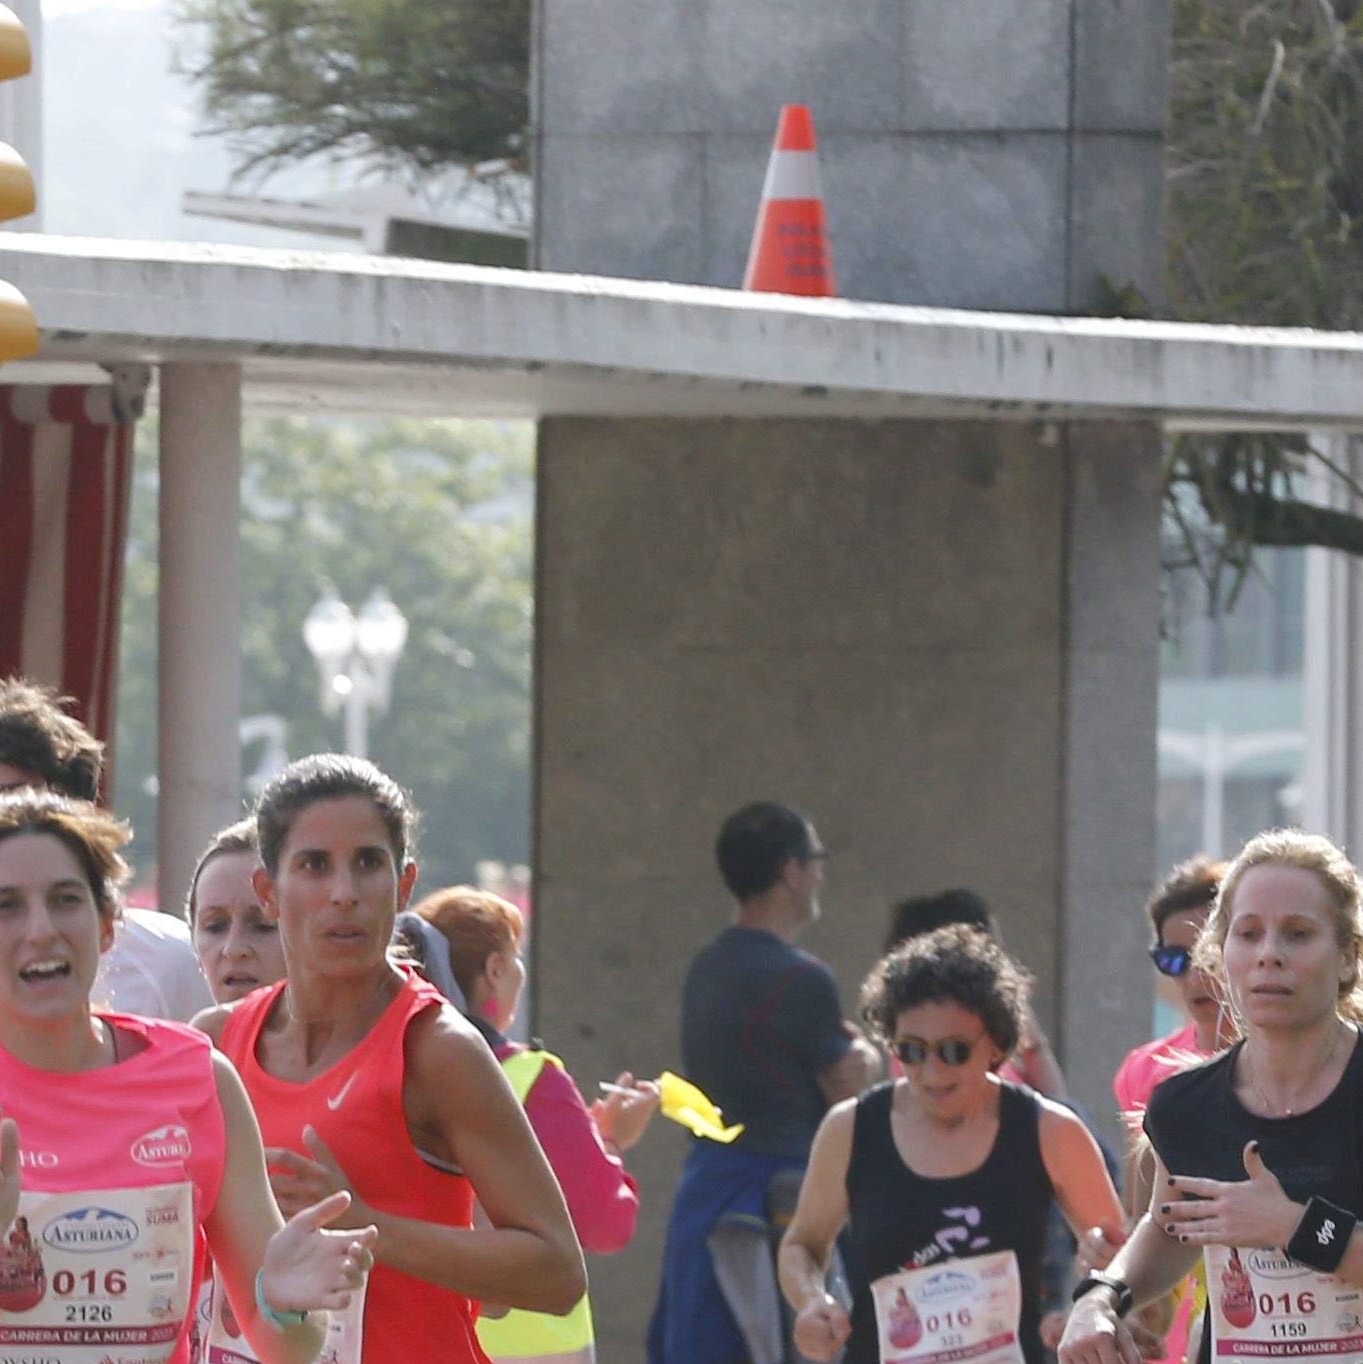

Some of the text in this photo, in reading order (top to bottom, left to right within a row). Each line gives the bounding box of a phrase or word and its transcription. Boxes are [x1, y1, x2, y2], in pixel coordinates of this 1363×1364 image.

[51, 1226, 132, 1243] ASTURIANA
[52, 1268, 128, 1296] 016
[1259, 1291, 1316, 1316] 016
[65, 1305, 113, 1322] 2126
[926, 1306, 972, 1333] 016
[0, 1330, 61, 1342] CARRERA
[63, 1331, 82, 1342] DE
[85, 1331, 101, 1342] LA
[102, 1330, 147, 1342] MUJER
[1270, 1322, 1308, 1338] 1159
[1271, 1344, 1285, 1354] DE
[1286, 1343, 1301, 1354] LA
[1302, 1342, 1338, 1353] MUJER
